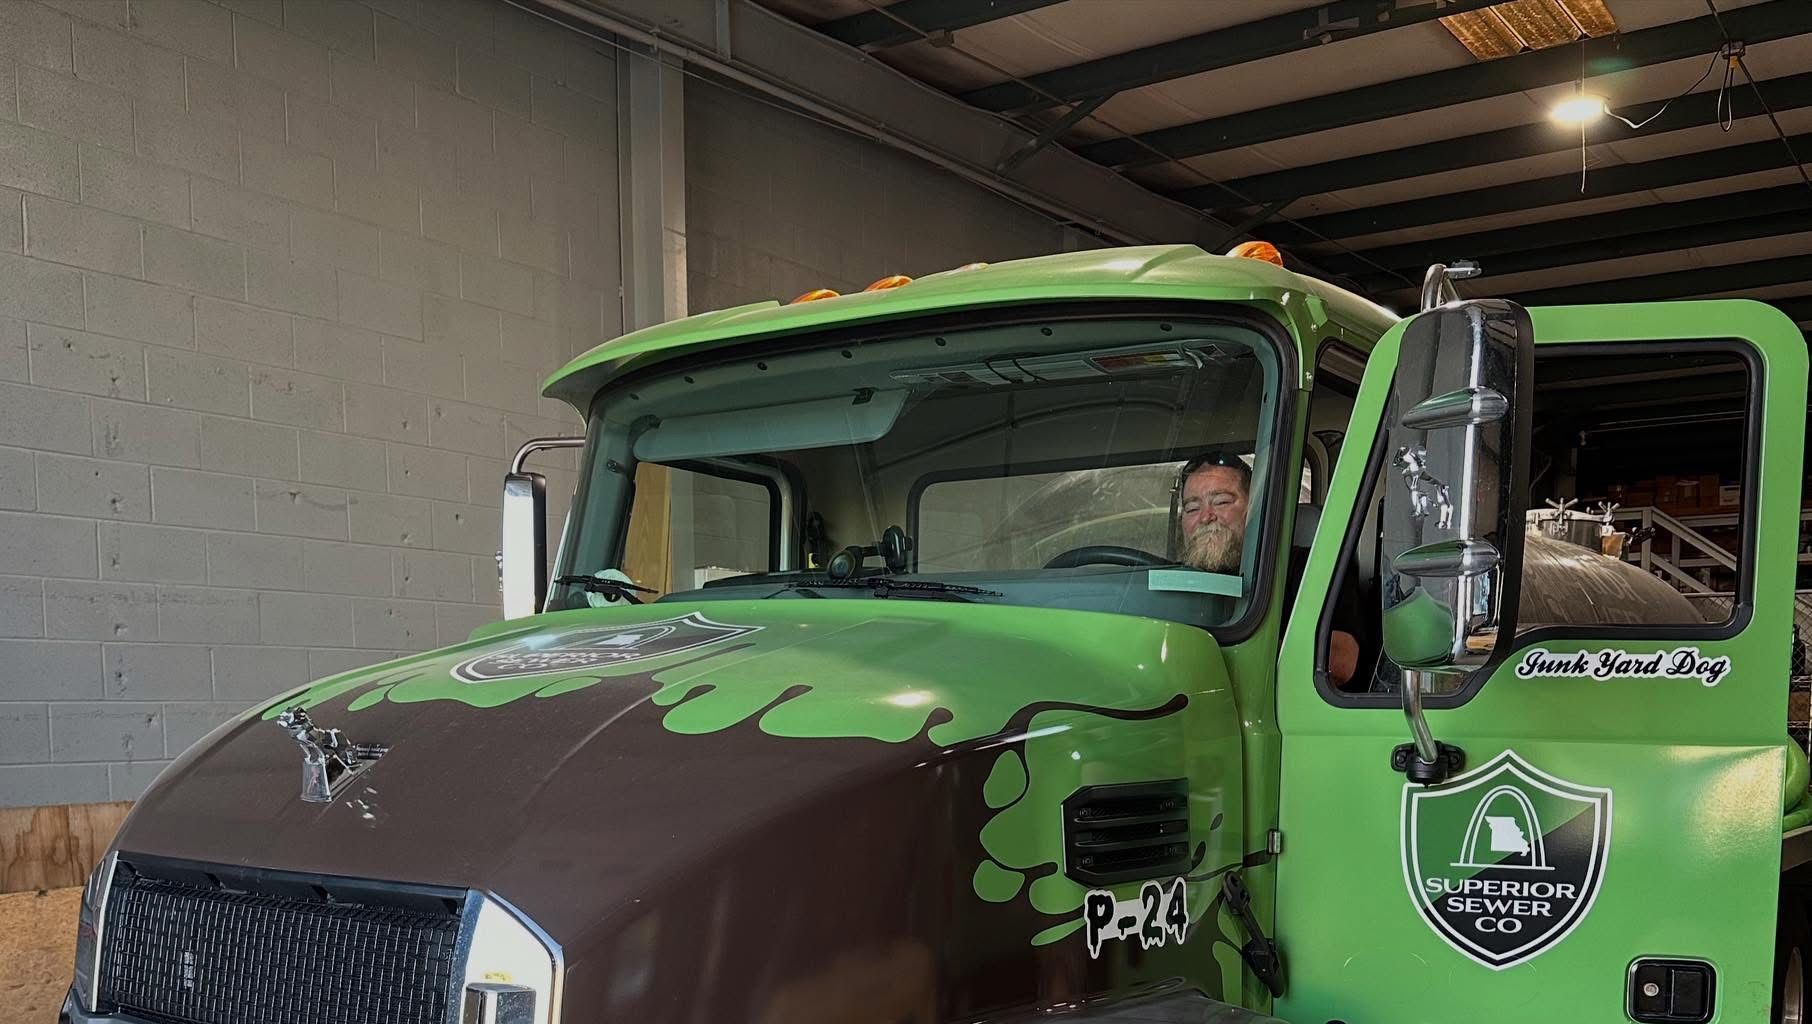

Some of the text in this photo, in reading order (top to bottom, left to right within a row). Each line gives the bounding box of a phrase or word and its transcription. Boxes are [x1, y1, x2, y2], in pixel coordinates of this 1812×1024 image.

[1517, 649, 1728, 684] Junk Yard Dog
[1425, 877, 1577, 899] SUPERIOR
[1086, 878, 1188, 958] P-24
[1446, 897, 1553, 917] SEWER
[1474, 917, 1523, 934] CO
